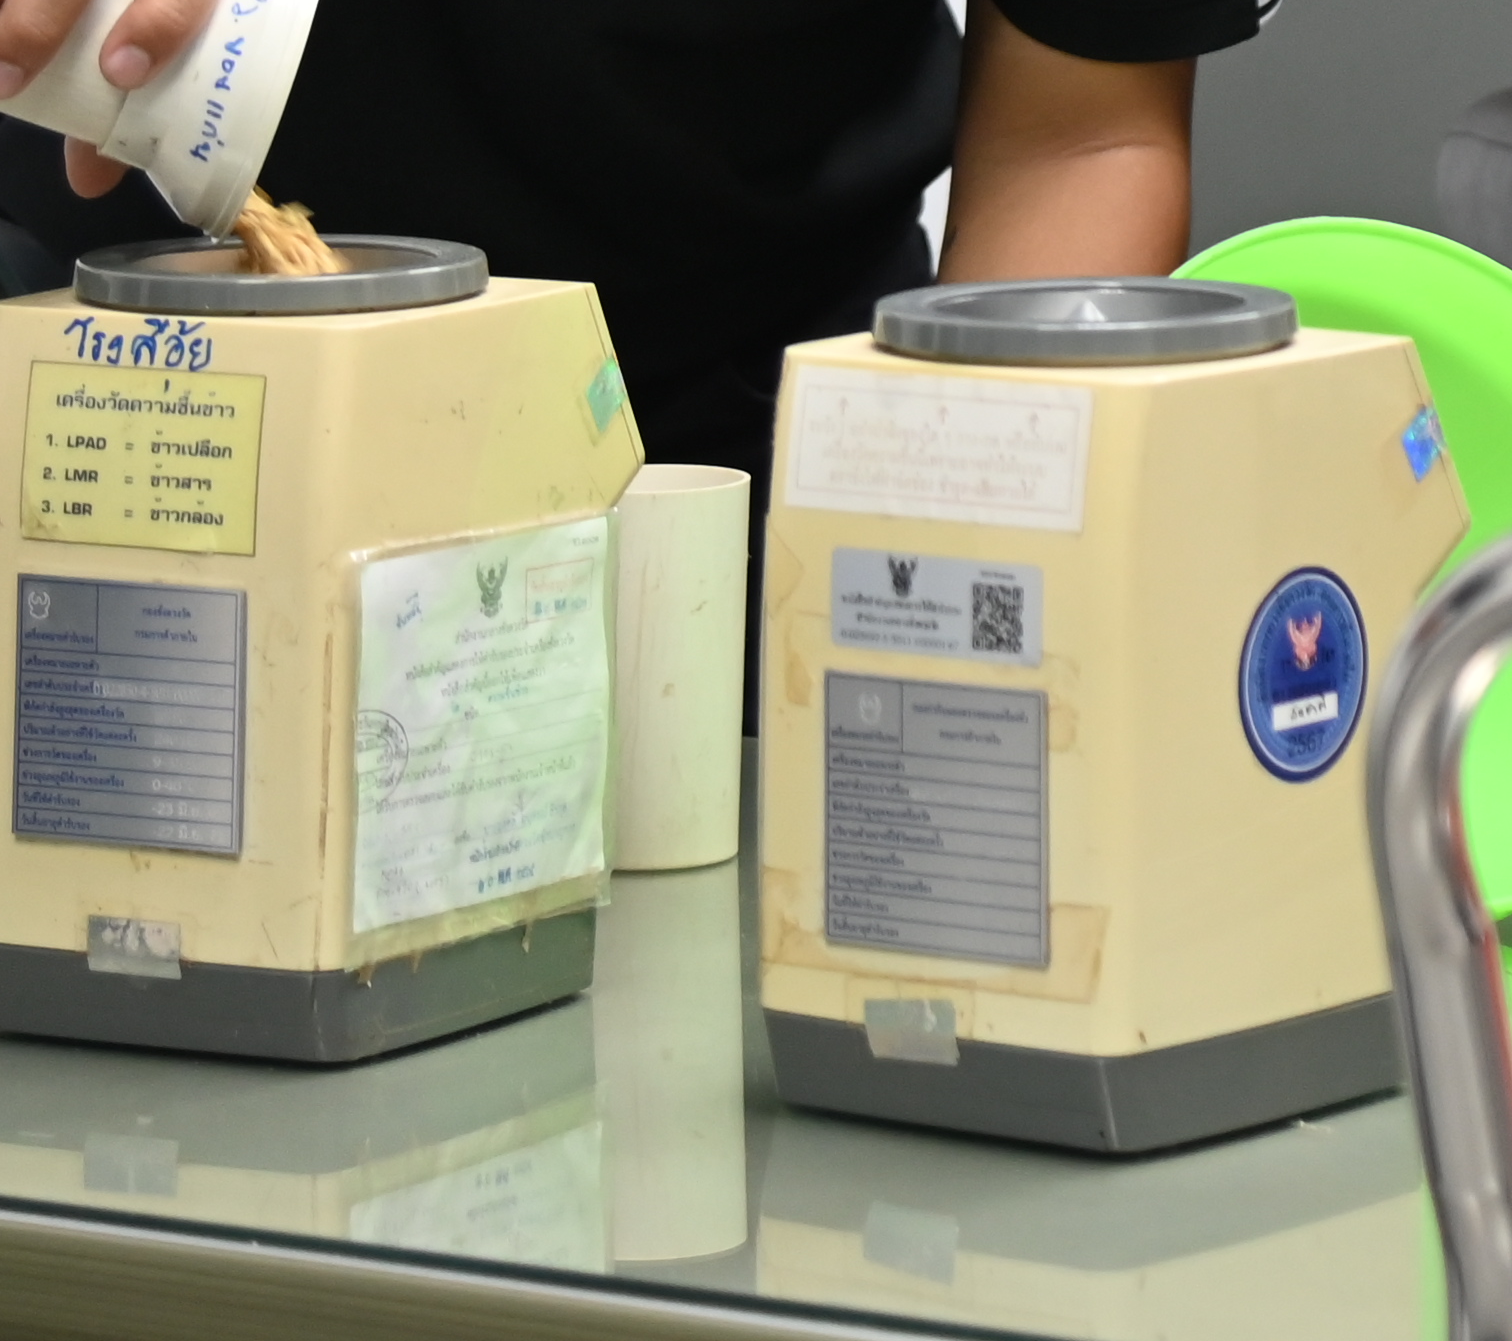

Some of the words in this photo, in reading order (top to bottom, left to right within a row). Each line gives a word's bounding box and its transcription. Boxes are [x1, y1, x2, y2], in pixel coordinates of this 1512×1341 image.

[55, 383, 236, 420] เครื่องวัดความชื้นข้าว
[45, 433, 59, 448] 1.
[66, 435, 107, 451] LPAD
[150, 429, 233, 460] ข้าวเปลือก
[42, 467, 57, 481] 2.
[64, 468, 99, 484] LMR
[150, 463, 212, 492] ข้าวสาร
[41, 500, 55, 514] 3.
[62, 501, 93, 517] LBR
[149, 496, 224, 526] ข้าวกล้อง
